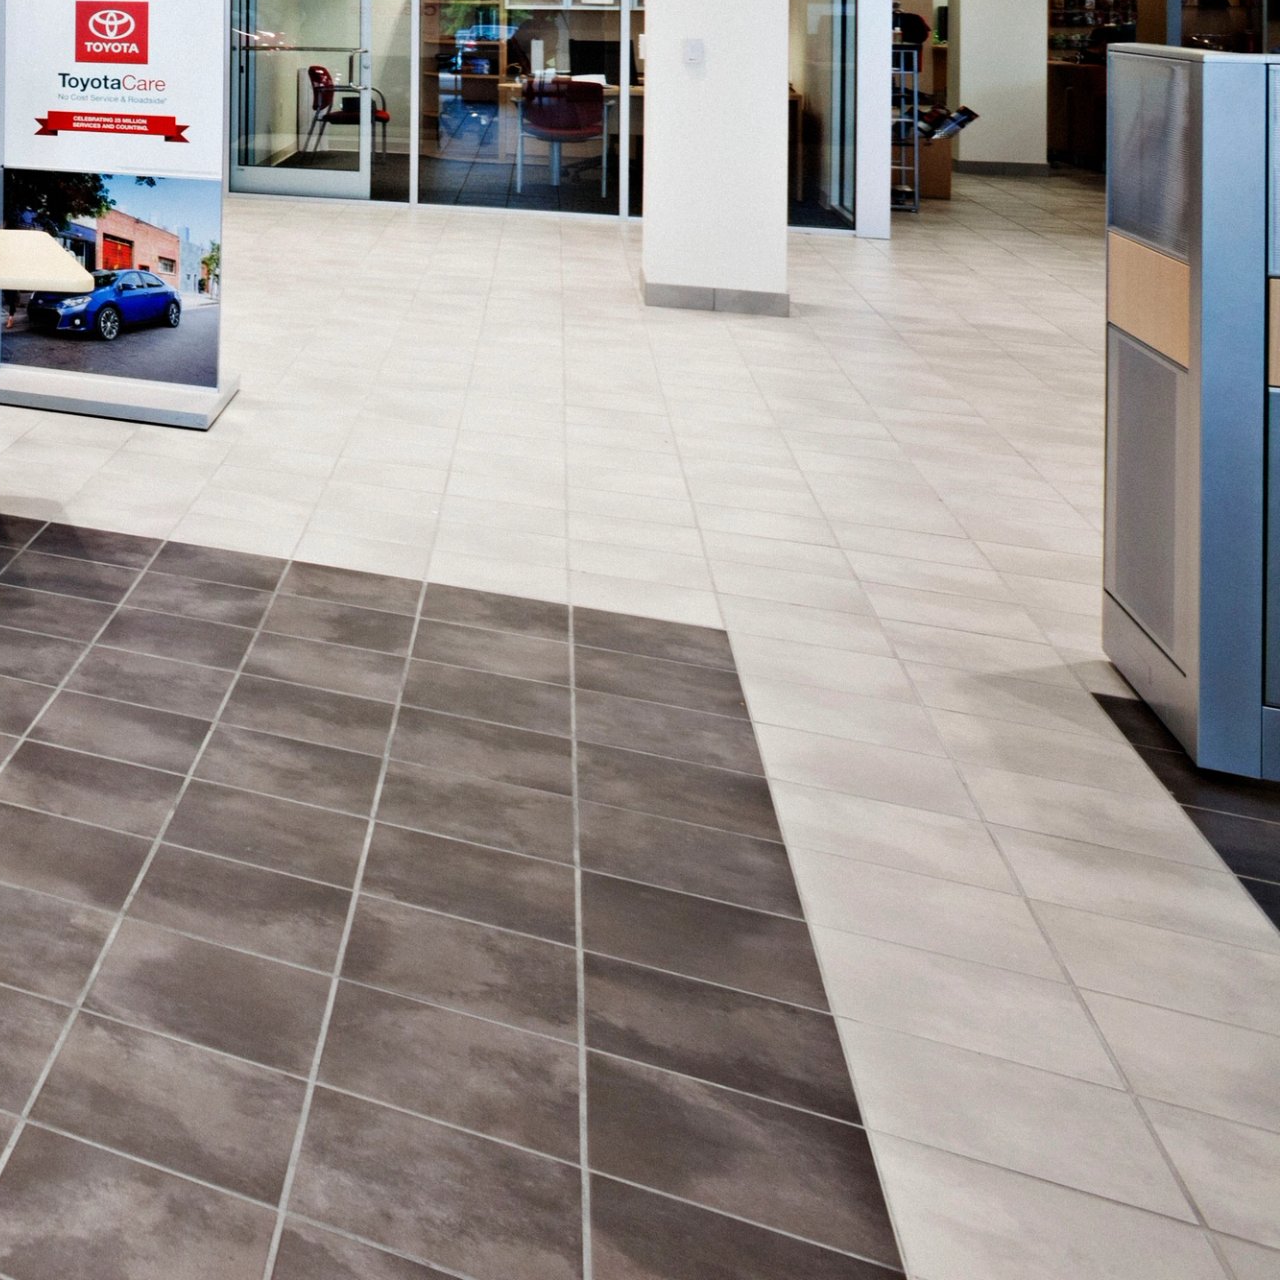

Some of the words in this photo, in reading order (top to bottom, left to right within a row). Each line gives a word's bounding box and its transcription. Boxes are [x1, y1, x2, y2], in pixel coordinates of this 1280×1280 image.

[84, 42, 139, 53] TOYOTA
[58, 73, 166, 92] ToyotaCare
[58, 93, 69, 101] No
[73, 115, 113, 123] CELEBRATING
